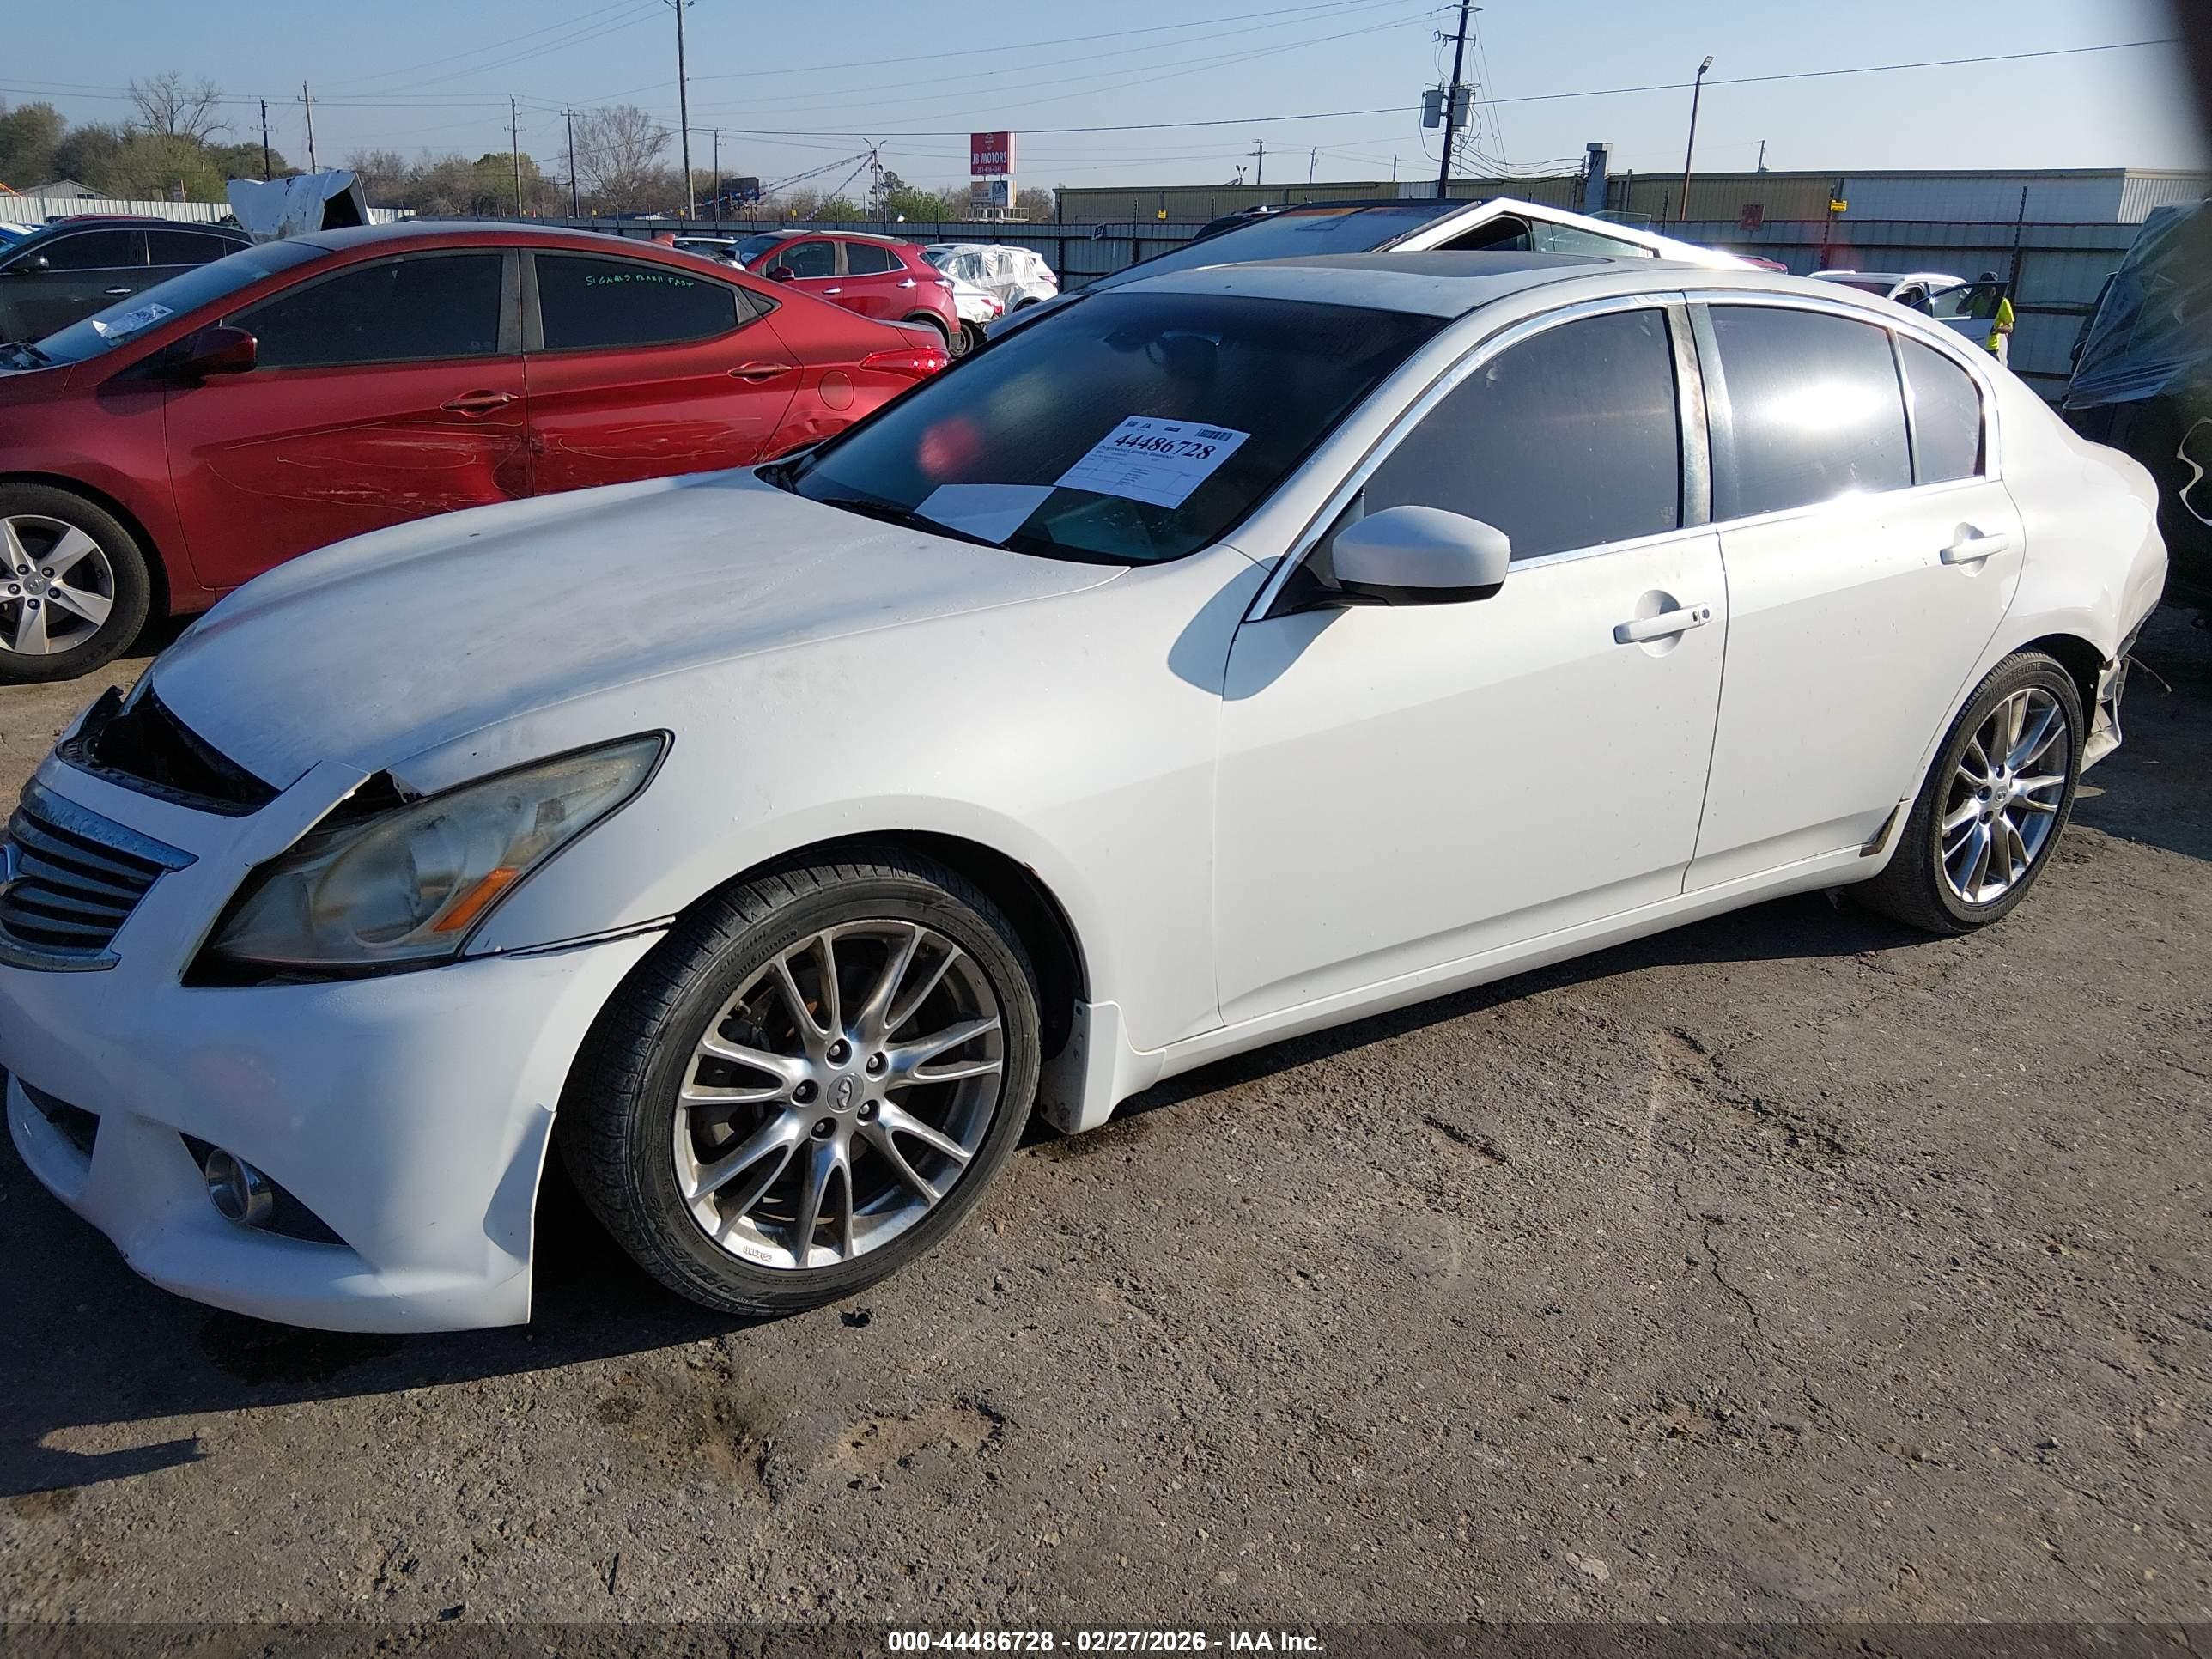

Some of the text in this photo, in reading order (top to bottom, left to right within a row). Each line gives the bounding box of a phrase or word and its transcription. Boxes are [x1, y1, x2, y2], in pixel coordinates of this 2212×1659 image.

[973, 151, 1007, 165] JB MOTORS
[668, 276, 695, 289] FAST
[1114, 433, 1217, 460] 44486728
